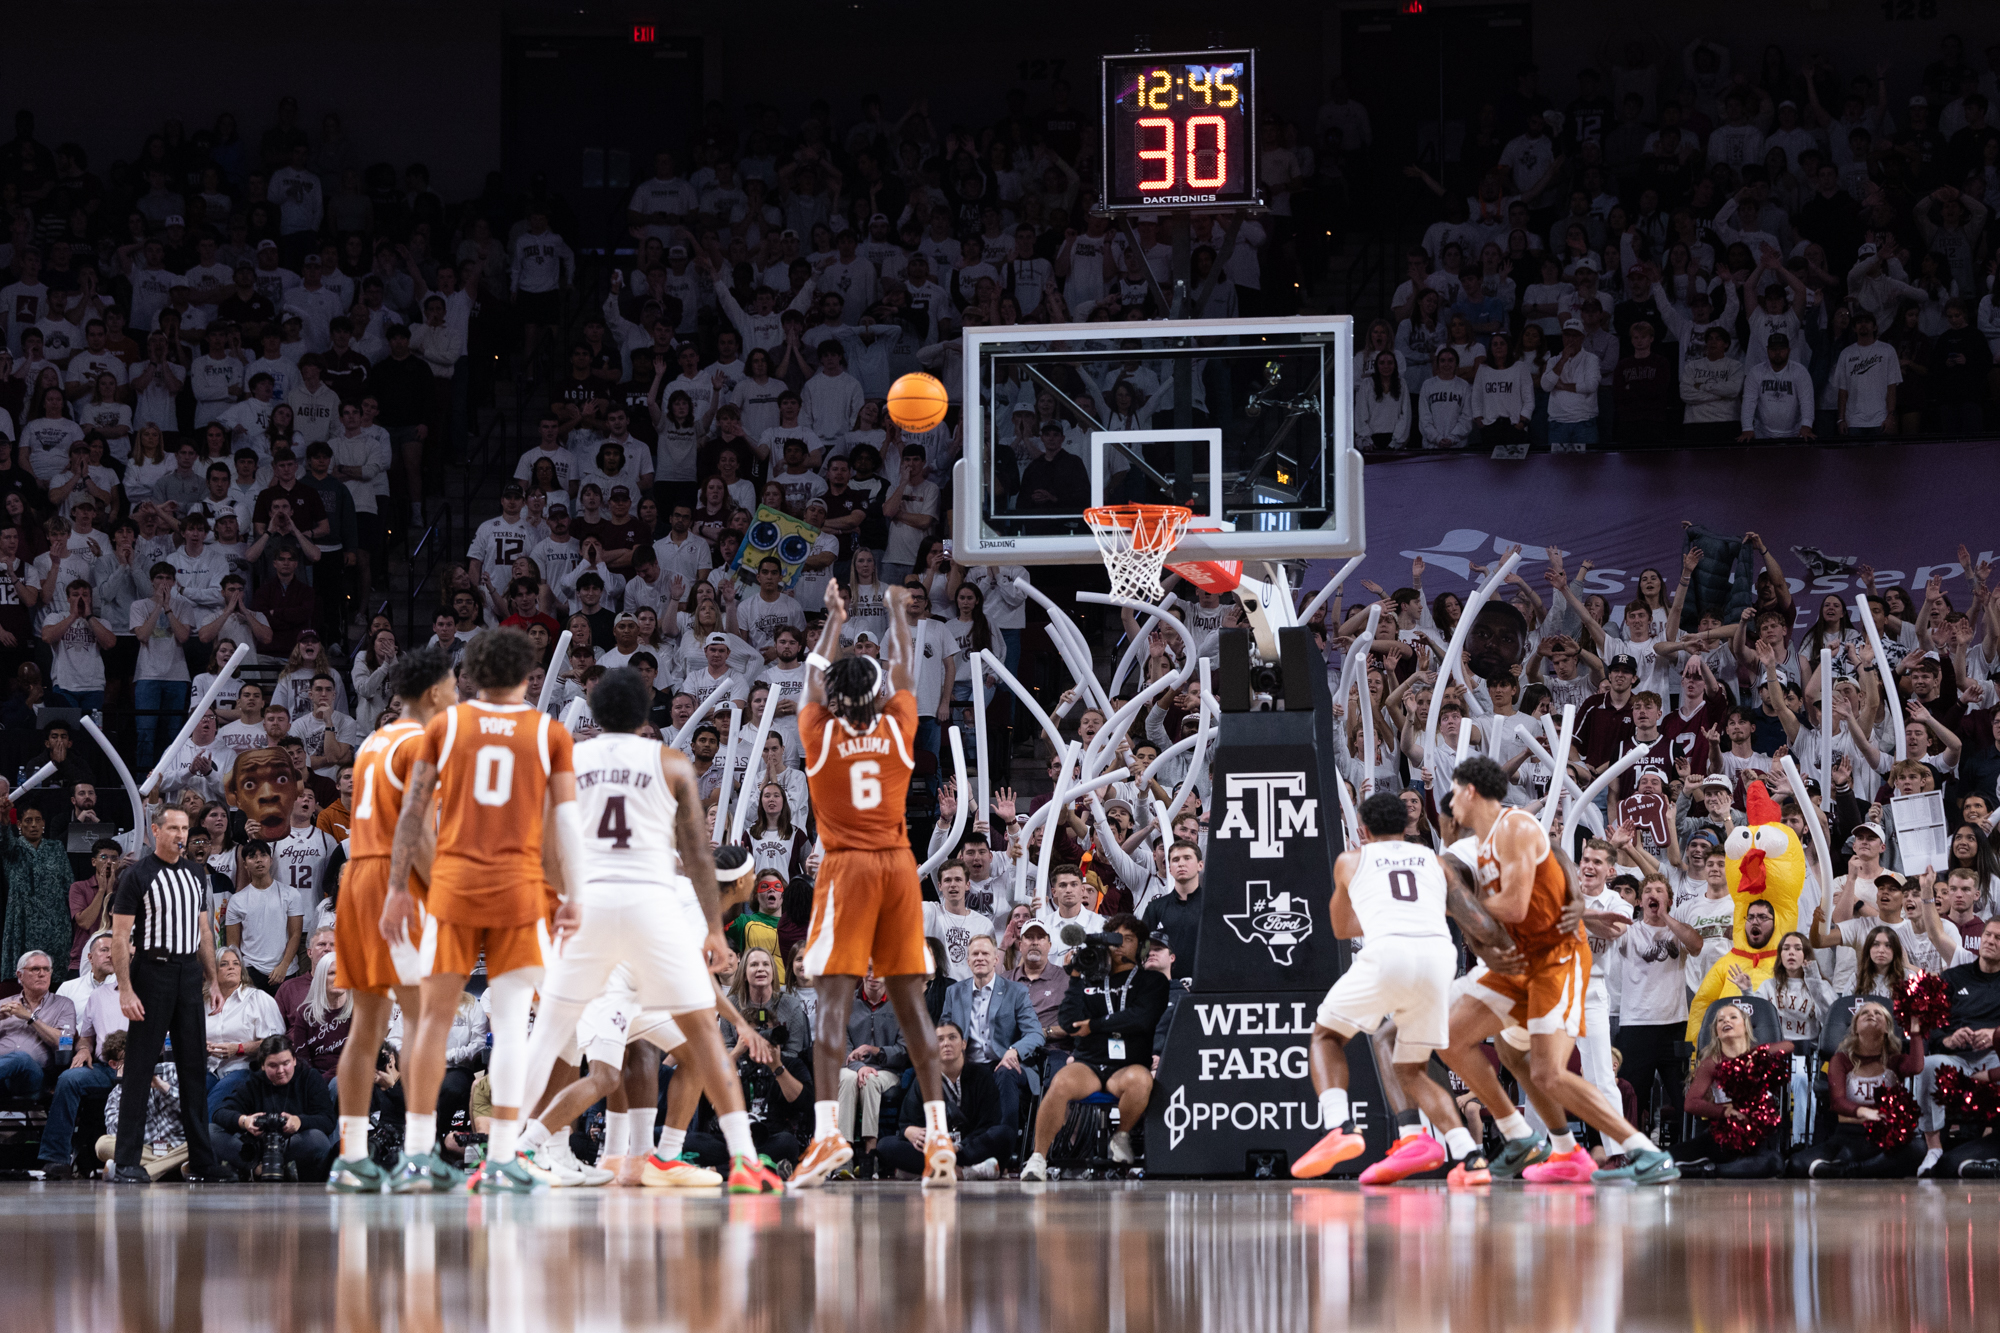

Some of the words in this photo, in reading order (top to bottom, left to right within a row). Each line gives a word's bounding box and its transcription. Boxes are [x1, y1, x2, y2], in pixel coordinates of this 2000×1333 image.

[1880, 0, 1938, 21] 128
[633, 26, 656, 42] EXIT
[1016, 59, 1066, 81] 127
[1136, 69, 1239, 110] 12:45
[1575, 115, 1602, 142] 12
[1137, 114, 1227, 191] 30
[1143, 194, 1217, 205] DAKTRONICS
[493, 531, 513, 539] TEXAS
[979, 539, 1016, 550] SPALDING
[494, 538, 524, 566] 12
[478, 715, 518, 737] POPE
[222, 734, 252, 747] TEXAS
[836, 736, 891, 759] KALUMA
[473, 744, 516, 807] 0
[577, 769, 631, 790] TAYLOR
[634, 772, 653, 789] IV
[849, 759, 883, 811] 6
[354, 762, 376, 820] 1
[597, 795, 633, 850] 4
[279, 845, 322, 865] Aggies
[1375, 856, 1426, 868] CARTER
[288, 865, 313, 889] 12
[1387, 869, 1419, 903] 0
[1262, 914, 1303, 932] Ford
[1692, 914, 1733, 928] Jesus
[1194, 1002, 1316, 1037] WELL
[1198, 1046, 1301, 1082] FARG
[1164, 1093, 1369, 1141] OPPORTUE
